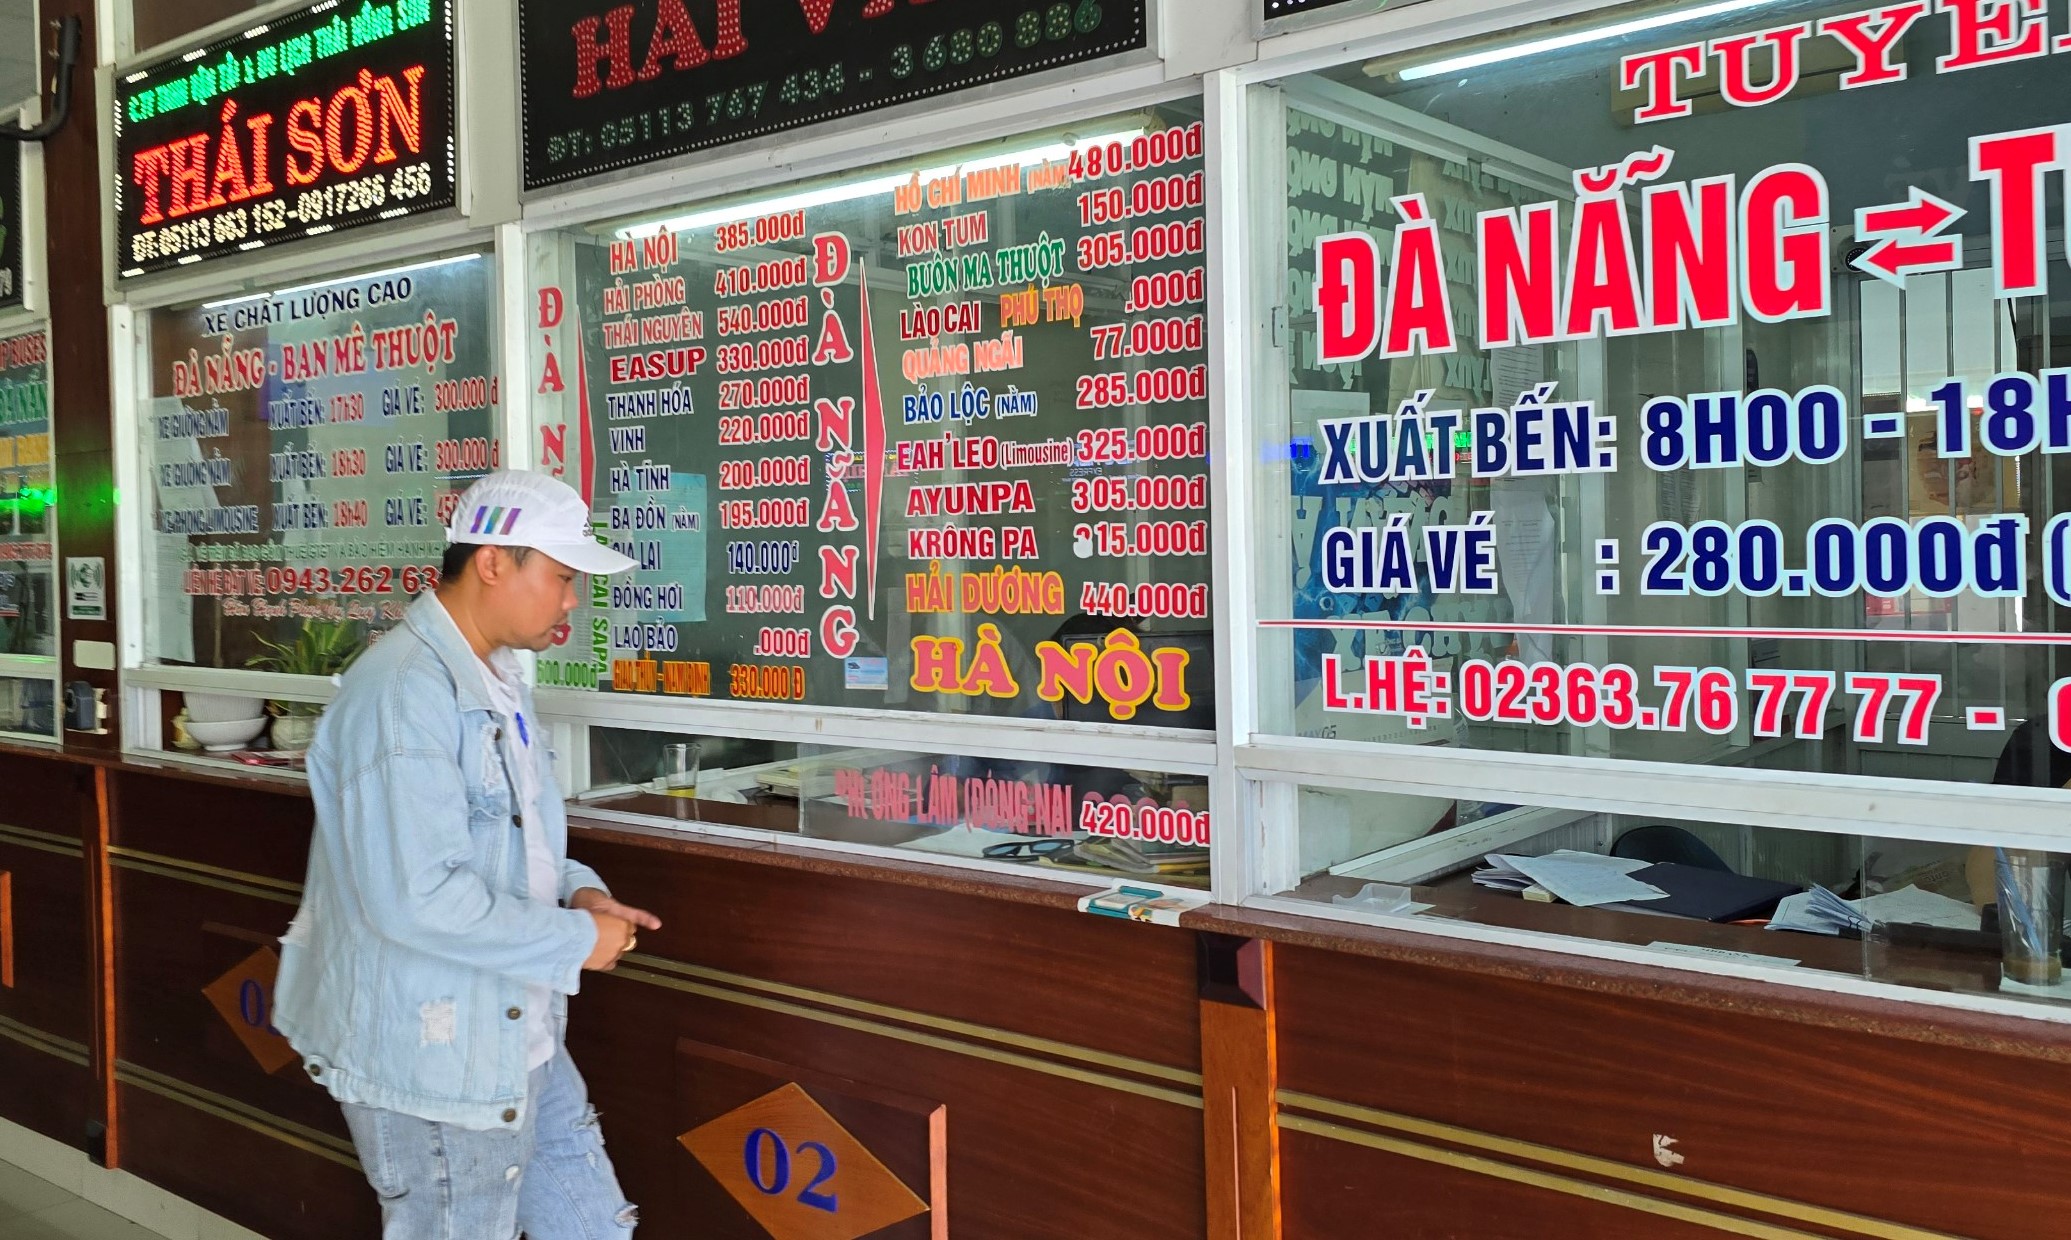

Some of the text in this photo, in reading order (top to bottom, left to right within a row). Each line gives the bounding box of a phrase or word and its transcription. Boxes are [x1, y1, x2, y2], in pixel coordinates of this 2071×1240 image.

[778, 62, 845, 105] 434
[134, 65, 426, 225] THÁI SƠN
[894, 120, 1205, 216] HỒ CHÍ MINH 480.000đ
[609, 209, 807, 275] HÀ NỘI 385.000đ
[897, 170, 1205, 258] KON TUM 150.000đ
[907, 216, 1205, 300] BUÔN MA THUỘT 305.000đ
[1317, 192, 1454, 366] ĐÀ
[1478, 145, 1831, 352] NẴNG
[1968, 126, 2071, 300] T
[202, 277, 412, 338] XE CHẤT LƯỢNG CAO
[604, 255, 808, 316] HẢI PHÒNG 410.000đ
[900, 265, 1205, 340] LÀO CAI PHÚ THỌ .000đ
[603, 295, 809, 349] THÁI NGUYÊN 540.000đ
[902, 315, 1205, 385] QUẢNG NGÃI 77.000đ
[172, 348, 203, 398] ĐÀ
[204, 334, 266, 395] NẴNG
[281, 340, 329, 383] BAN
[333, 321, 368, 377] MÊ
[371, 308, 460, 375] THUỘT
[610, 335, 809, 384] EASUP 330.000đ
[434, 376, 488, 414] 300.000
[608, 375, 810, 420] THANH HÓA 270.000đ
[903, 384, 944, 425] BẢO
[949, 381, 990, 426] LỘC
[1076, 363, 1207, 410] 285.000đ
[435, 438, 489, 472] 300.000
[609, 410, 810, 454] VINH 220.000đ
[1000, 436, 1074, 469] (Limousine)
[1076, 422, 1207, 463] 325.000đ
[1319, 388, 1462, 486] XUẤT
[1473, 378, 1618, 479] BẾN:
[1640, 387, 1842, 473] 8H00
[610, 464, 633, 494] HÀ
[719, 456, 810, 490] 200.000đ
[905, 474, 1207, 517] AYUNPA 305.000đ
[611, 506, 631, 530] BA
[635, 495, 666, 530] ĐỒN
[719, 498, 810, 530] 195.000đ
[908, 521, 997, 560] KRÔNG
[1001, 526, 1040, 560] PA
[265, 565, 393, 596] 0943.262
[640, 540, 800, 575] LAI 140.000đ
[1324, 511, 1420, 595] GIÁ
[1423, 510, 1498, 595] VÉ
[1640, 513, 2030, 600] 280.000đ
[612, 576, 653, 611] ĐỒNG
[726, 585, 804, 614] 110.000đ
[905, 559, 1208, 618] HẢI DƯƠNG 440.000đ
[613, 615, 811, 658] LAO BẢO .000đ
[910, 622, 1192, 721] HÀ NỘI
[1322, 647, 1453, 730] L.HỆ:
[1460, 658, 1740, 737] 02363.76
[1035, 783, 1073, 837] NAI
[1079, 801, 1211, 848] 420.000đ
[742, 1125, 839, 1215] 02
